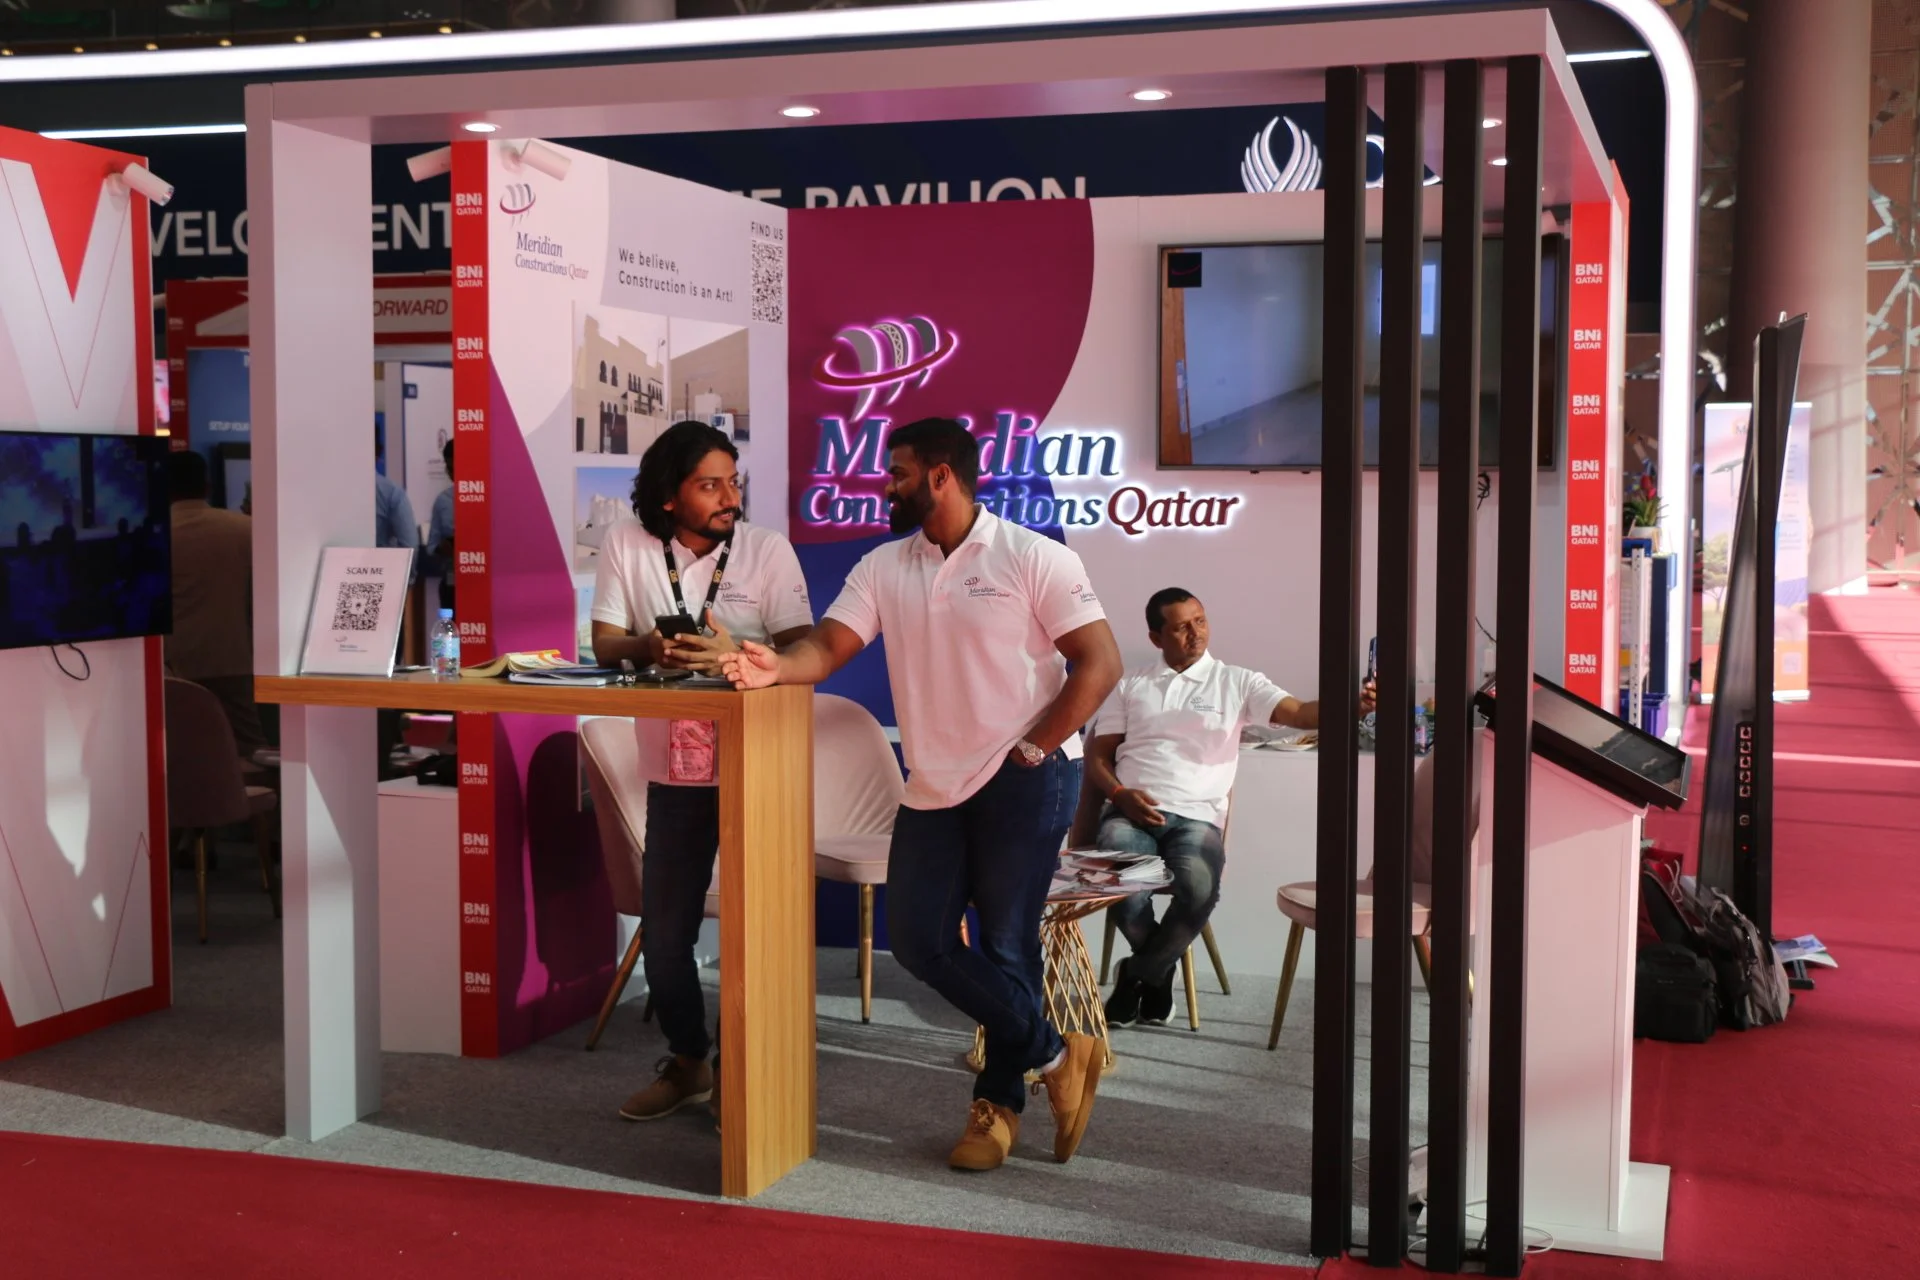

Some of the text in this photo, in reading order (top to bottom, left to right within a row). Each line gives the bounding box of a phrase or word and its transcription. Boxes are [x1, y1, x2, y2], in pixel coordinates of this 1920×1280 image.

[456, 206, 482, 216] QATAR
[751, 221, 784, 240] FIND US
[516, 231, 563, 257] Meridian
[515, 253, 567, 276] Constructions
[618, 247, 680, 274] We believe,
[457, 279, 482, 288] QATAR
[1576, 275, 1602, 285] QATAR
[618, 270, 734, 302] Construction is an Art!
[1574, 341, 1600, 350] QATAR
[457, 351, 483, 360] QATAR
[1573, 407, 1599, 416] QATAR
[458, 422, 483, 432] QATAR
[1572, 472, 1599, 481] QATAR
[459, 494, 484, 503] QATAR
[1107, 486, 1239, 535] Qatar
[1571, 537, 1598, 545] QATAR
[346, 567, 384, 575] SCAN ME
[460, 565, 485, 574] QATAR
[1570, 601, 1597, 610] QATAR
[460, 635, 486, 645] QATAR
[1569, 666, 1596, 674] QATAR
